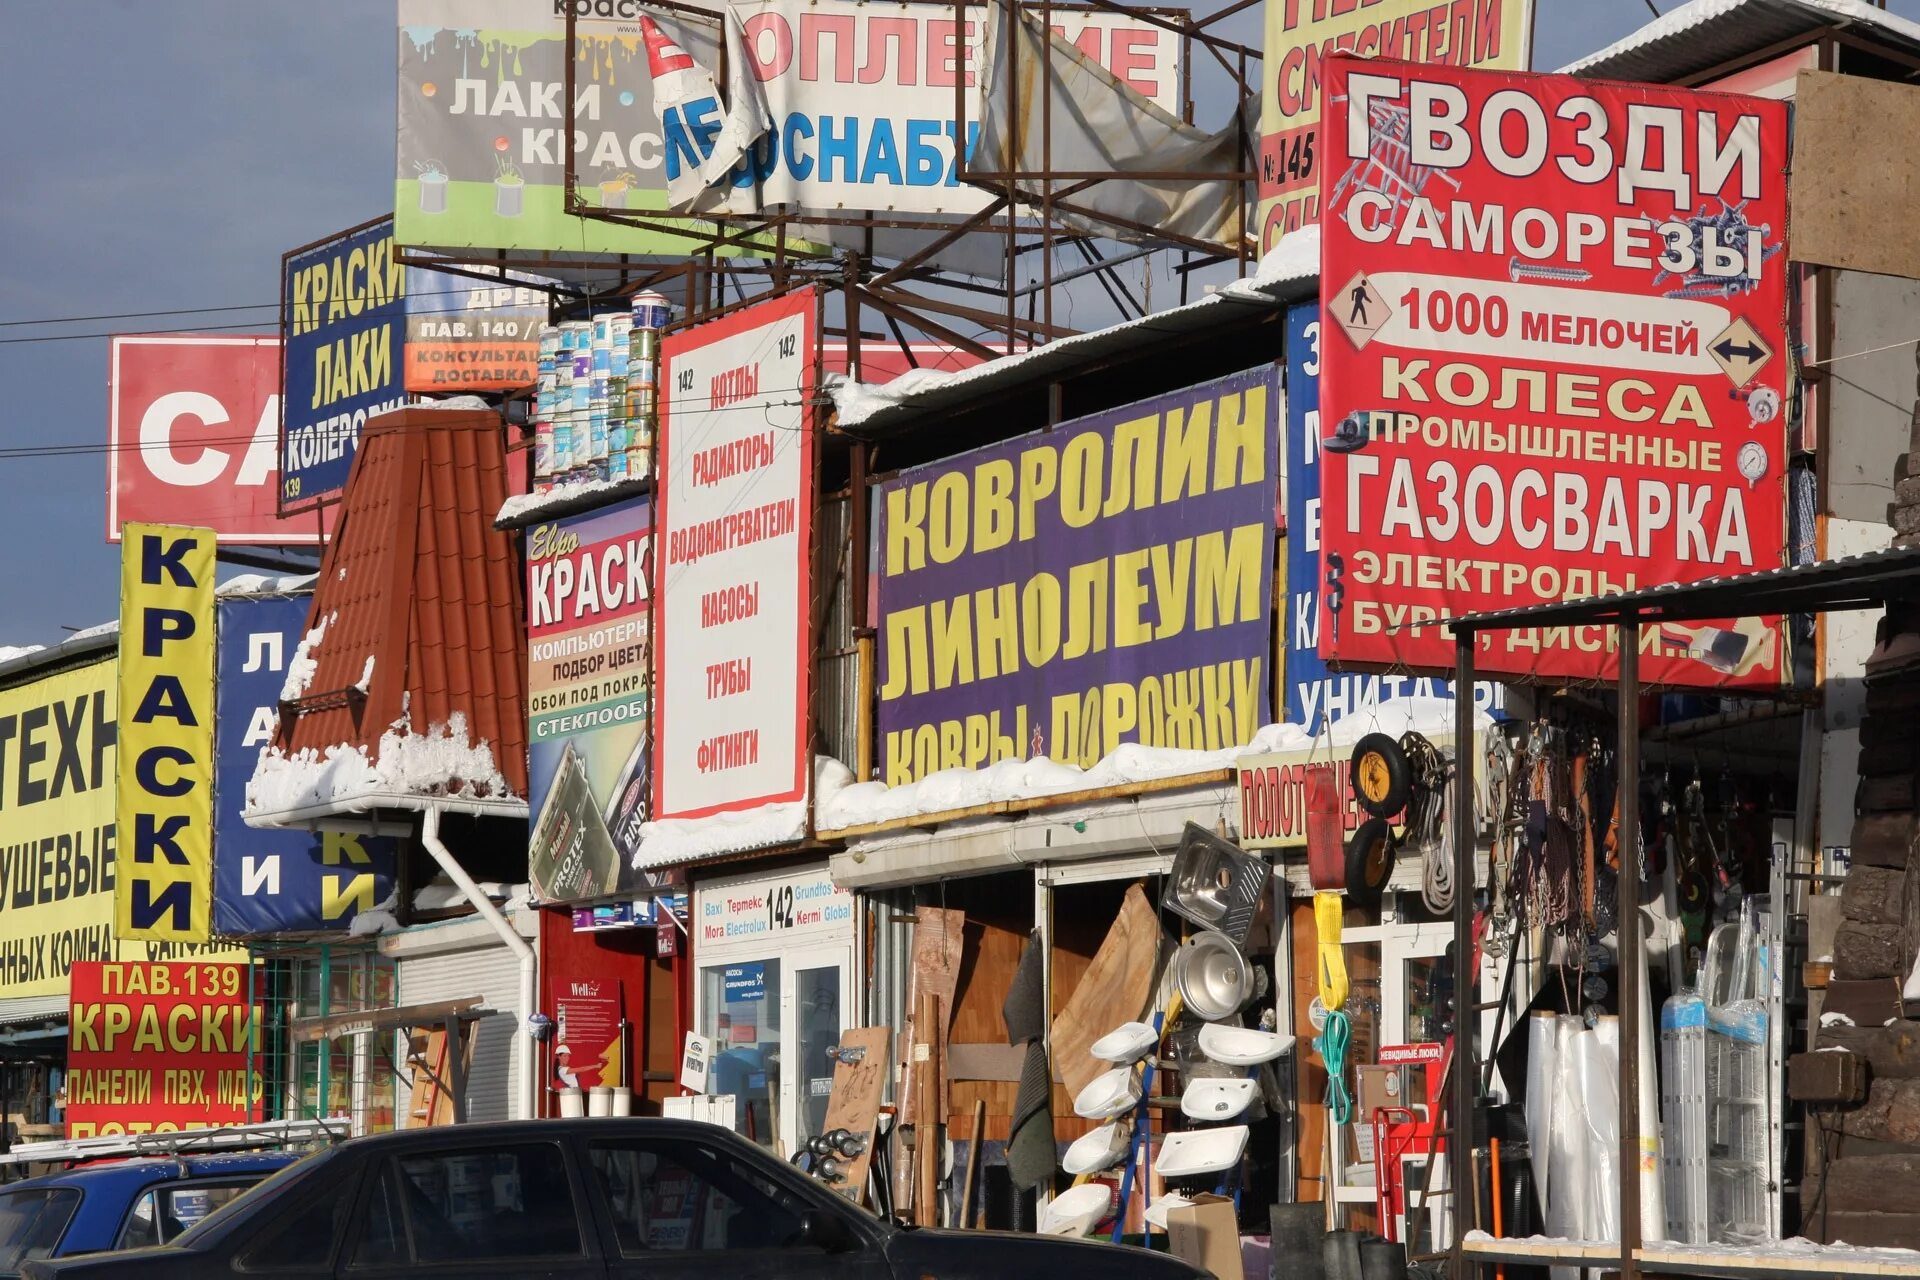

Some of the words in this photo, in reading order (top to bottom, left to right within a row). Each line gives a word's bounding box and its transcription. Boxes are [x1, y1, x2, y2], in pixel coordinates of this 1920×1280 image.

[449, 78, 600, 120] ЛАКИ
[1277, 131, 1315, 185] 145
[1346, 72, 1762, 211] ГВОЗДИ
[1346, 190, 1764, 280] САМОРЕЗЫ
[293, 235, 406, 337] КРАСКИ
[421, 322, 473, 337] ПАВ.
[481, 321, 518, 337] 140
[779, 333, 796, 360] 142
[1400, 286, 1509, 338] 1000
[1521, 311, 1699, 357] МЕЛОЧЕЙ
[312, 322, 391, 410] ЛАКИ
[678, 368, 694, 393] 142
[711, 362, 760, 411] КОТЛЫ
[1382, 356, 1714, 429] КОЛЕСА
[139, 391, 286, 487] СА
[693, 430, 775, 488] РАДИАТОРЫ
[1368, 411, 1723, 472] ПРОМЫШЛЕННЫЕ
[284, 477, 301, 499] 139
[886, 385, 1267, 578] КОВРОЛИН
[1346, 453, 1754, 566] ГАЗОСВАРКА
[670, 498, 796, 566] ВОДОНАГРЕВАТЕЛИ
[1352, 550, 1637, 602] ЭЛЕКТРОДЫ
[701, 581, 759, 628] НАСОСЫ
[881, 522, 1264, 702] ЛИНОЛЕУМ
[553, 656, 604, 682] ПОДБОР
[706, 656, 752, 700] ТРУБЫ
[532, 693, 567, 712] ОБОИ
[571, 685, 598, 705] ПОД
[1298, 675, 1505, 736] УНИТАЫ
[131, 534, 199, 932] КРАСКИ
[697, 729, 759, 774] ФИТИНГИ
[886, 704, 1027, 790] КОВРЫ
[553, 820, 587, 897] PROTEX
[705, 901, 723, 916] Baxi
[727, 896, 763, 916] Термекс
[766, 885, 794, 931] 142
[795, 882, 832, 900] Grundfos
[705, 925, 725, 940] Mora
[726, 918, 767, 937] Electrolux
[796, 907, 821, 925] Kermi
[824, 903, 851, 921] Global
[71, 1002, 263, 1054] КРАСКИ
[67, 1069, 152, 1105] ПАНЕЛИ
[164, 1069, 210, 1112] ПВХ,
[217, 1069, 264, 1112] МДФ
